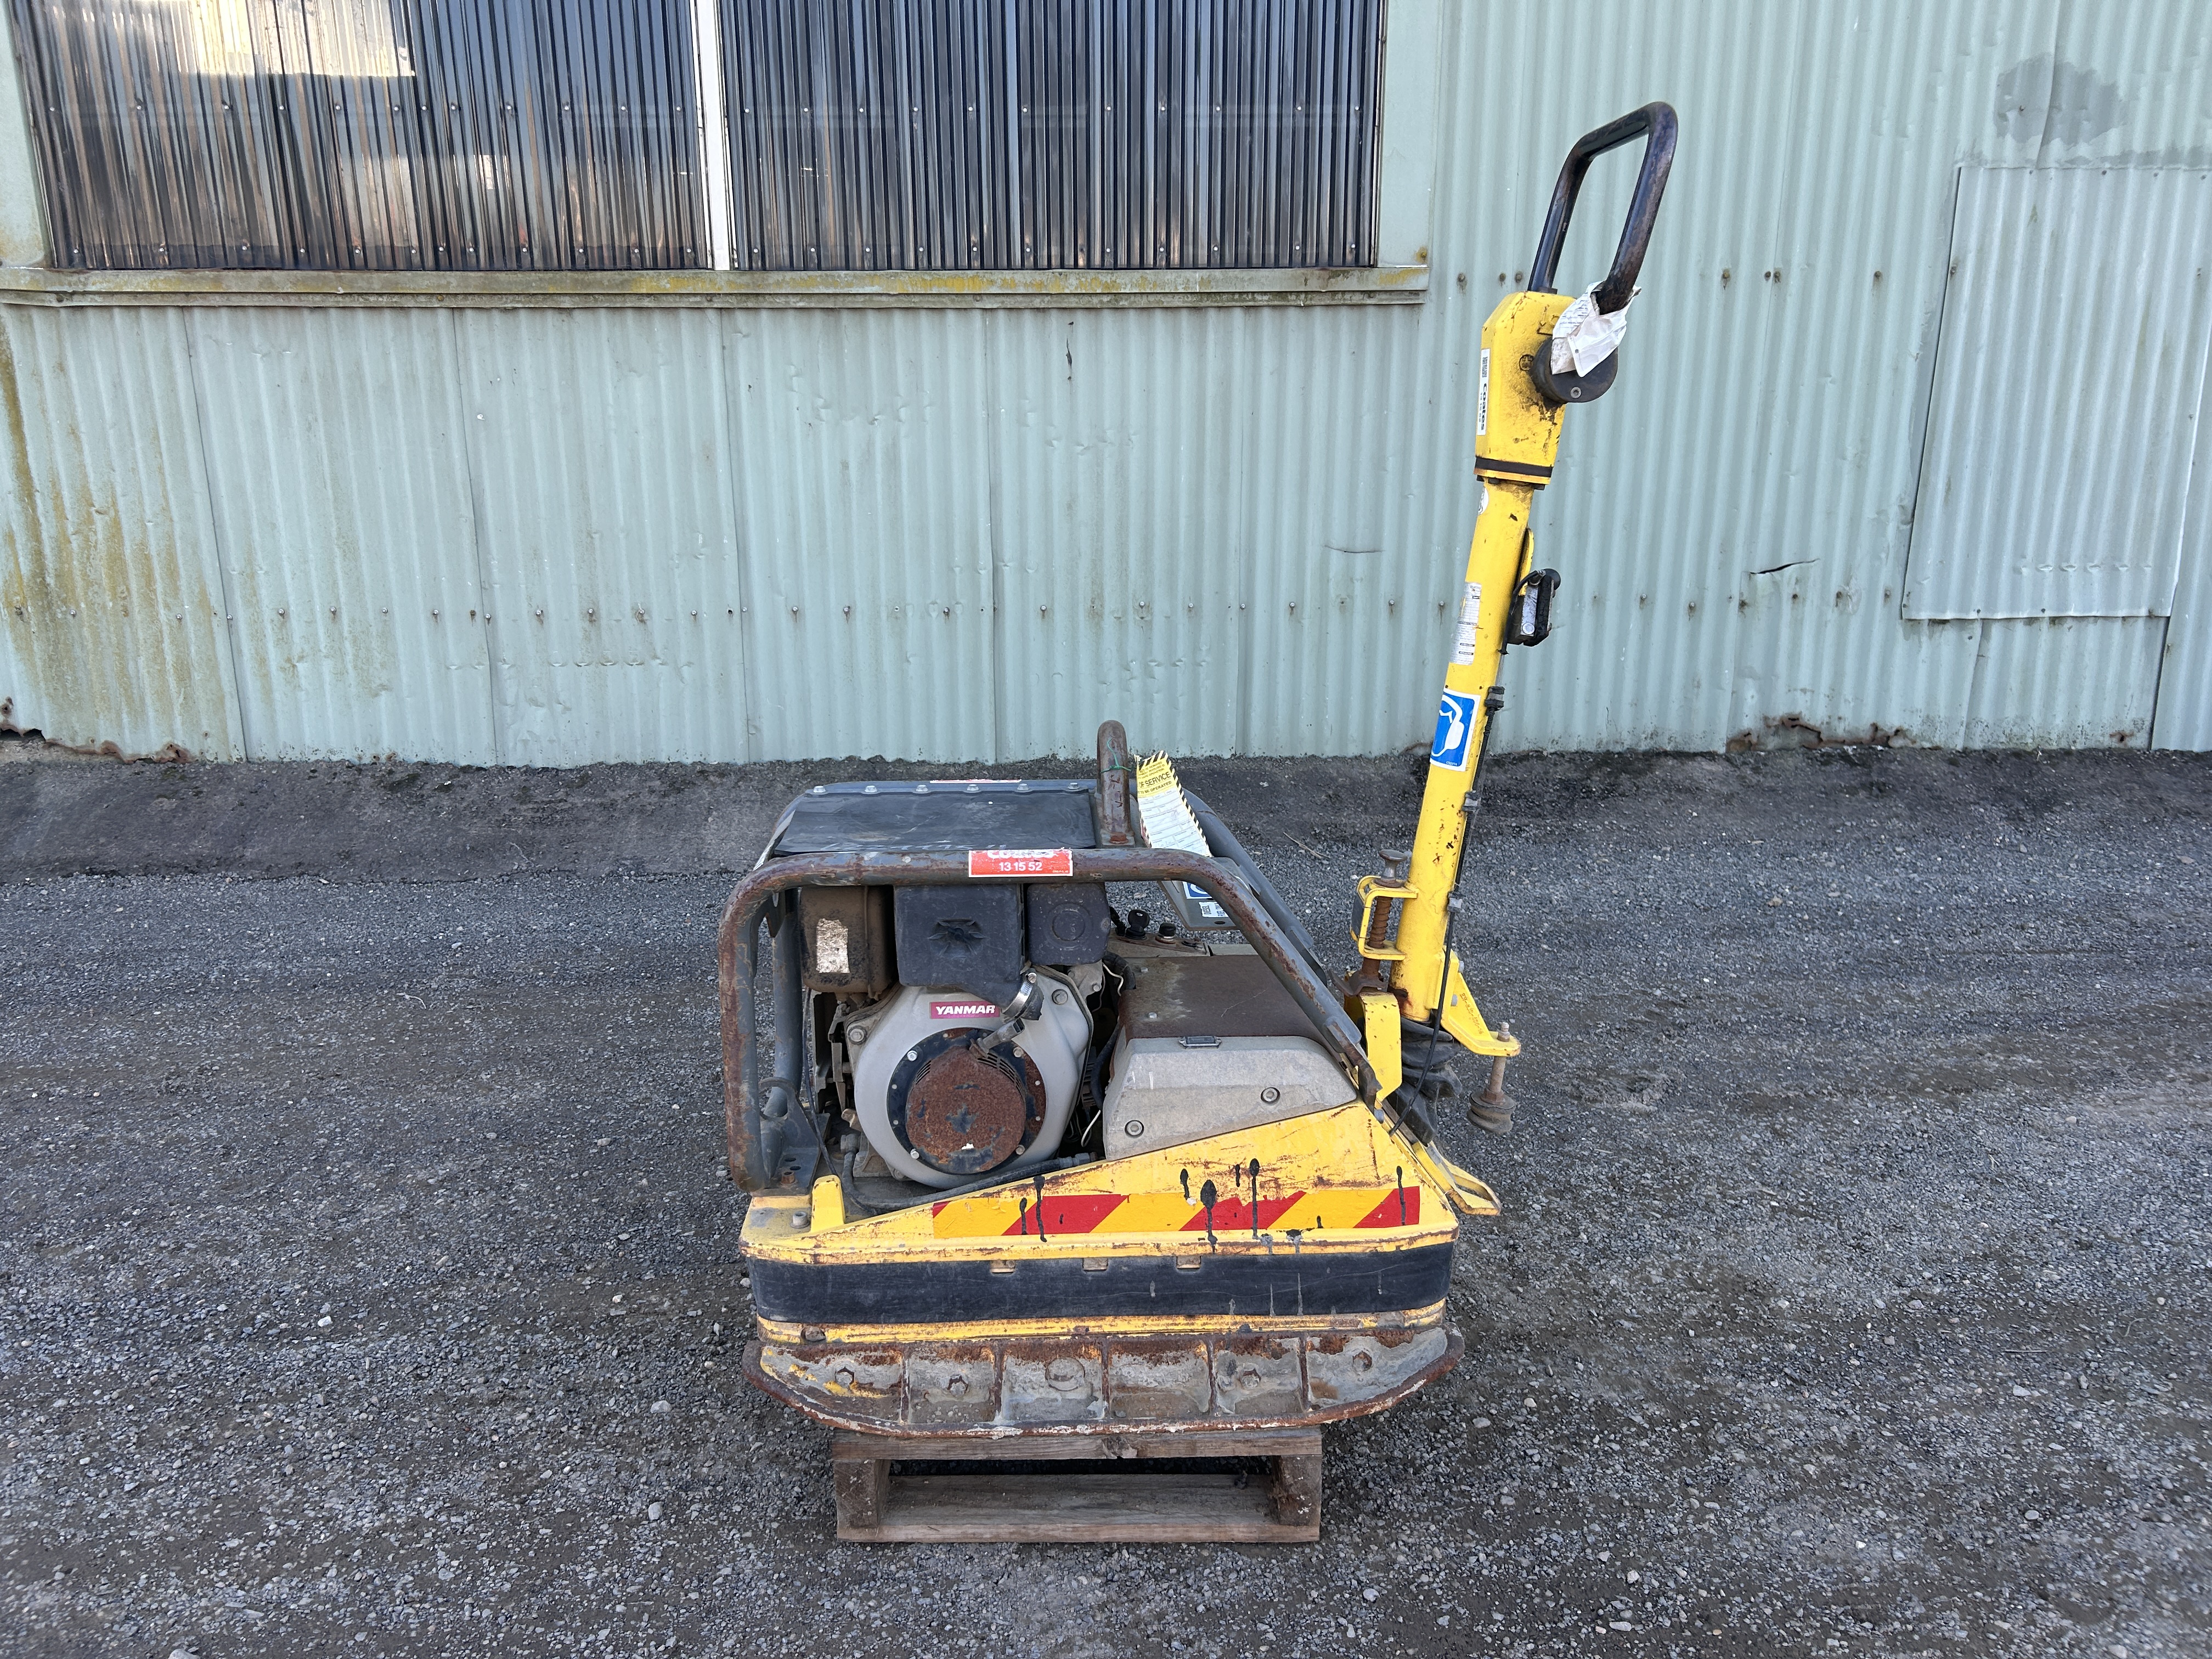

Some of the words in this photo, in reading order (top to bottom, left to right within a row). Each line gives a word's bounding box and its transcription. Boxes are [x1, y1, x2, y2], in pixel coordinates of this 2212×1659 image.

[1145, 772, 1171, 787] SERVICE
[1150, 781, 1172, 792] OPERATED
[999, 861, 1012, 871] 13
[1014, 861, 1026, 871] 15
[1028, 861, 1043, 871] 52
[936, 1005, 995, 1015] YANMAR
